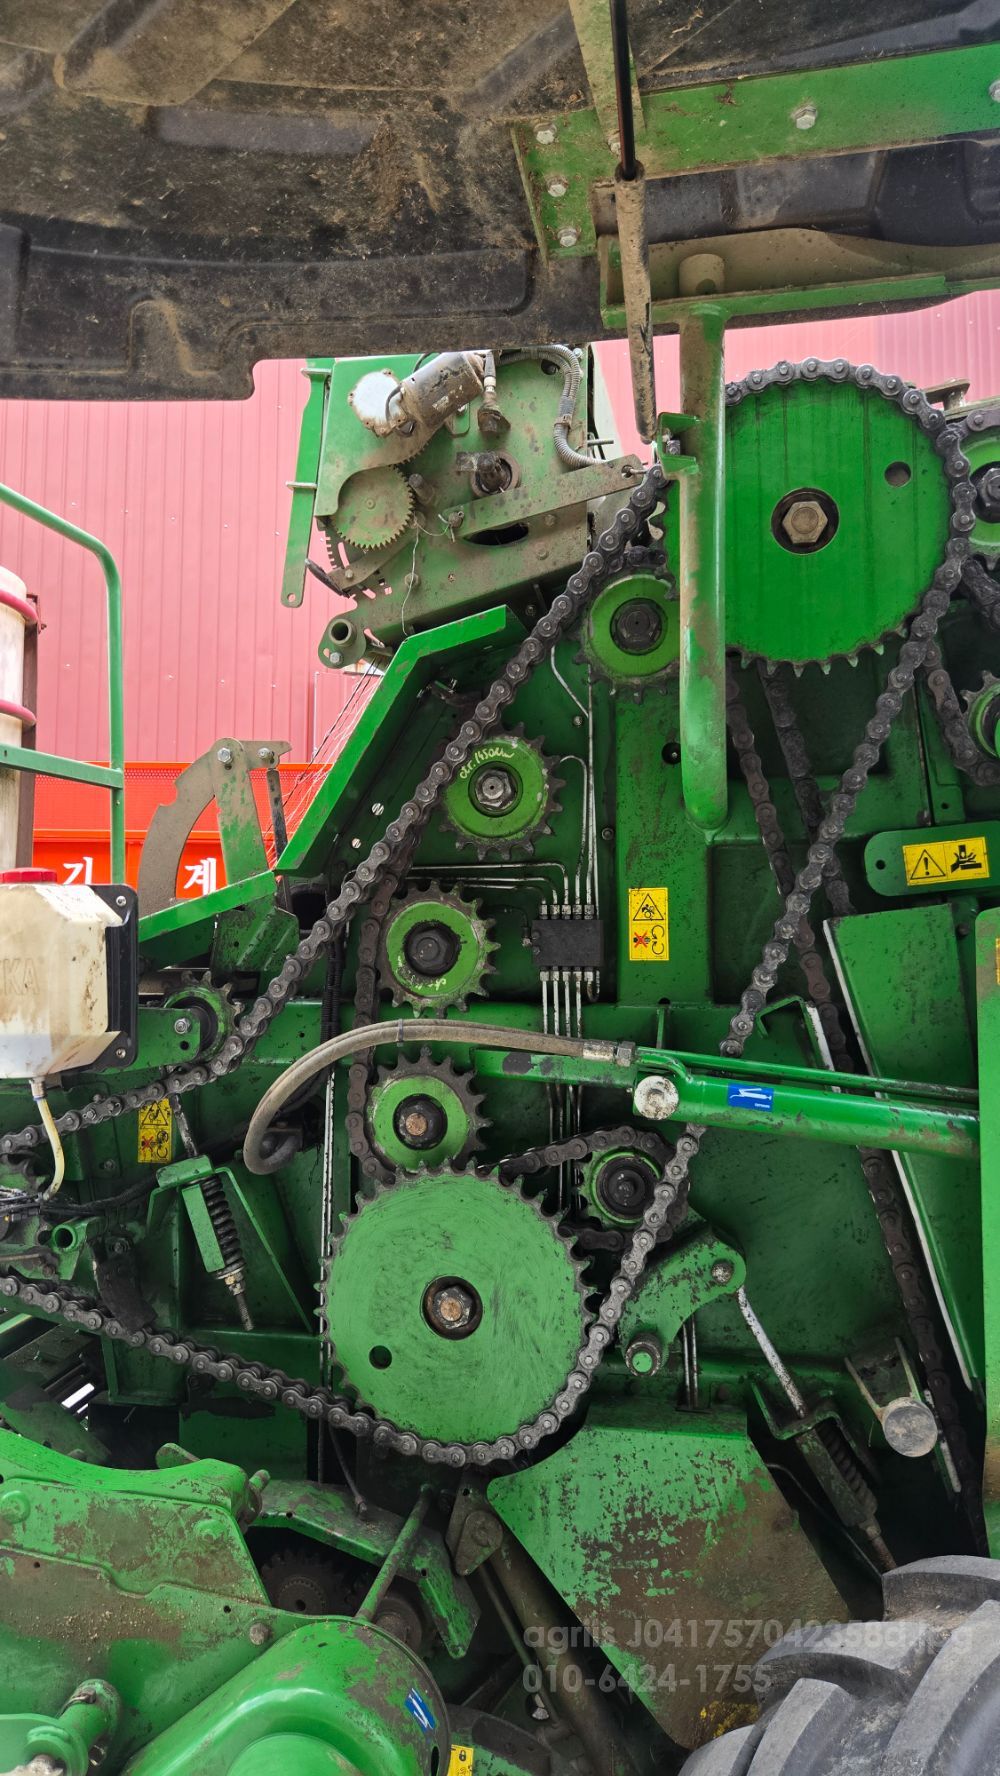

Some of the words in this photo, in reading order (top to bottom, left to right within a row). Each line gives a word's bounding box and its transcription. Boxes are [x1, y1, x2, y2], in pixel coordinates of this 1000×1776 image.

[63, 856, 93, 885] 기
[184, 857, 217, 895] 계
[0, 957, 41, 996] KA
